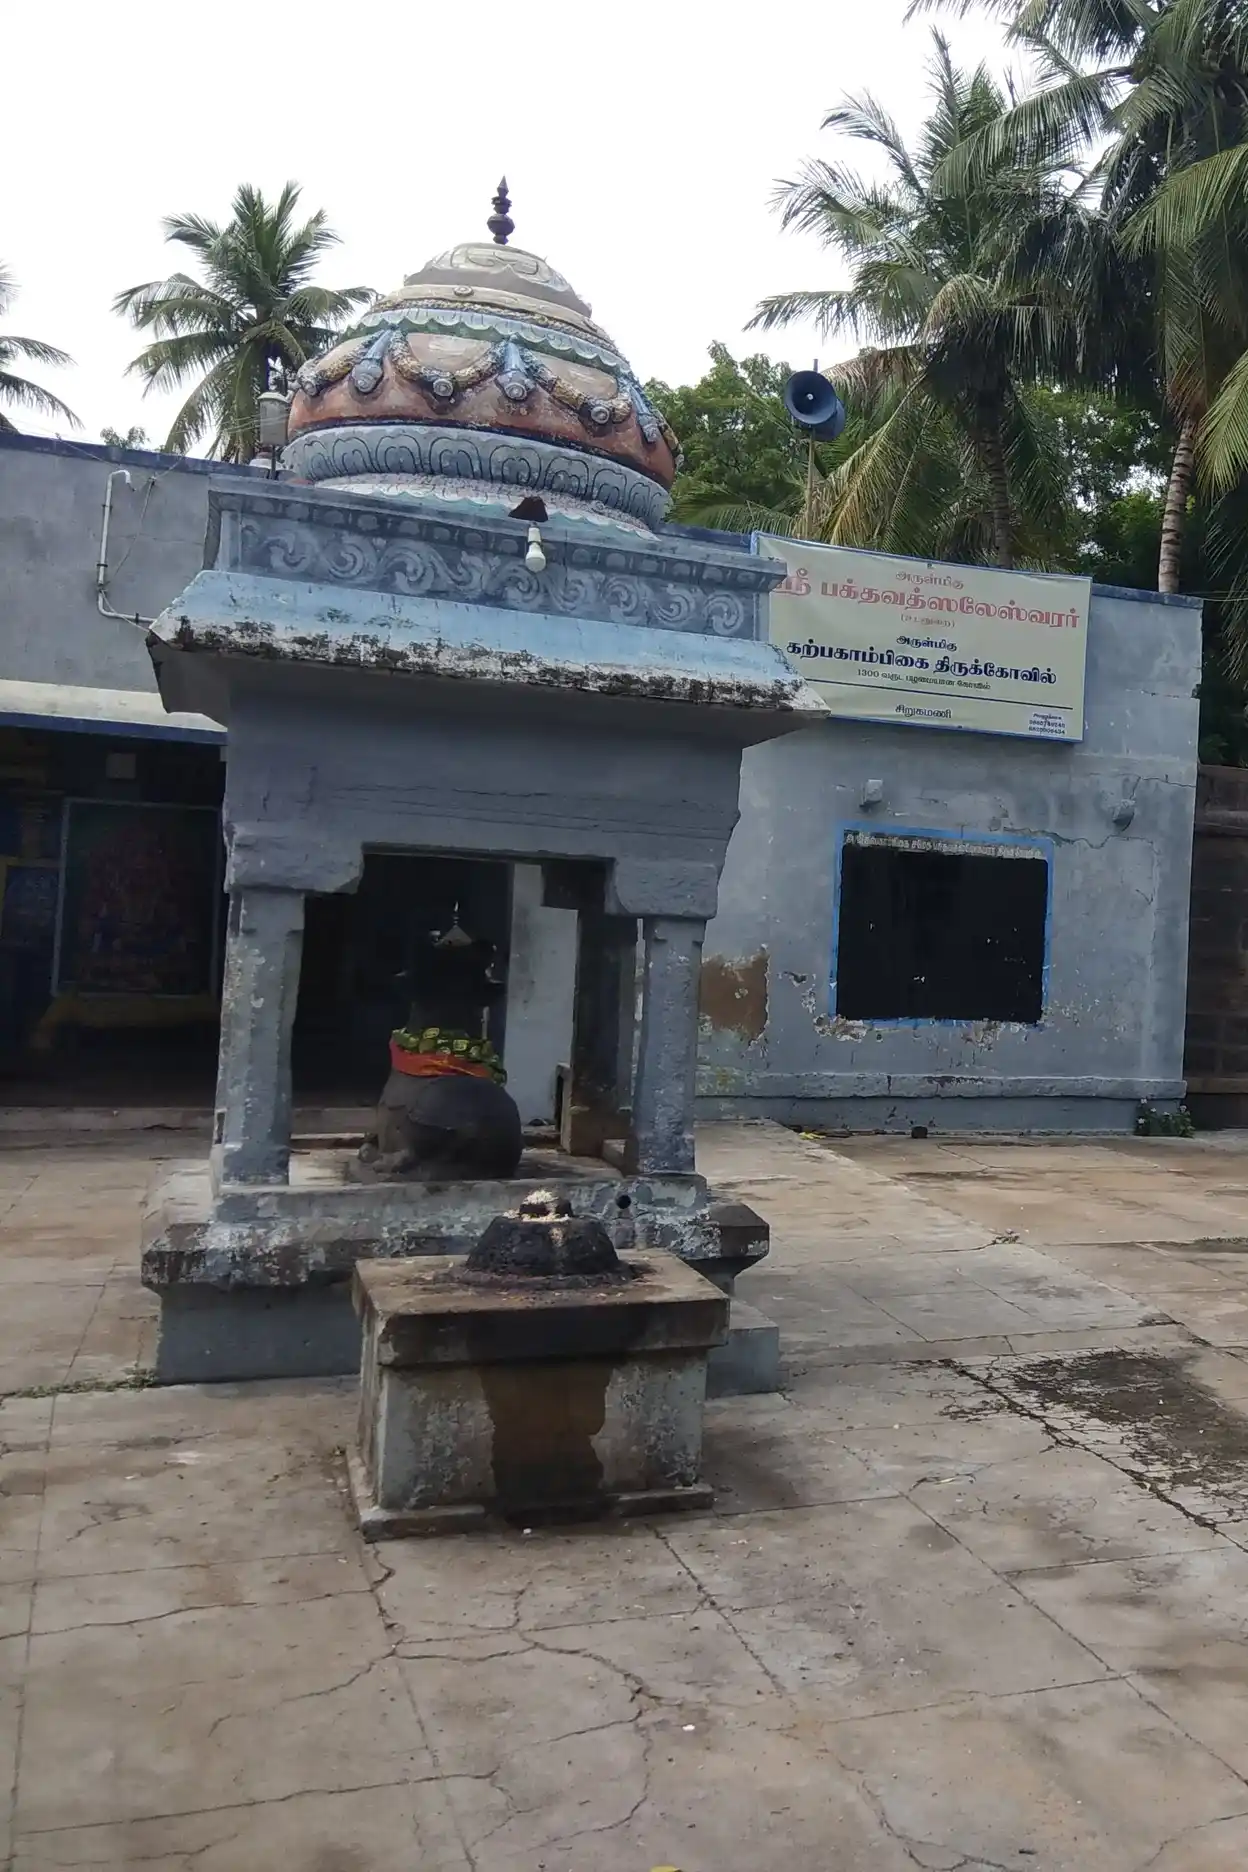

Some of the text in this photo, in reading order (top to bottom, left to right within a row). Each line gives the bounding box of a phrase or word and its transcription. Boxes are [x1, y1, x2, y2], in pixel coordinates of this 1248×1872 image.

[896, 570, 964, 591] அருள்மிகு
[821, 578, 1080, 629] பக்தவத்ஸலேஸ்வரர்
[896, 635, 958, 652] அருள்மிகு
[786, 638, 1057, 685] கற்பகாம்பிகை திருக்கோவில்
[857, 668, 880, 678] 1300
[895, 704, 952, 719] சிறுகமணி
